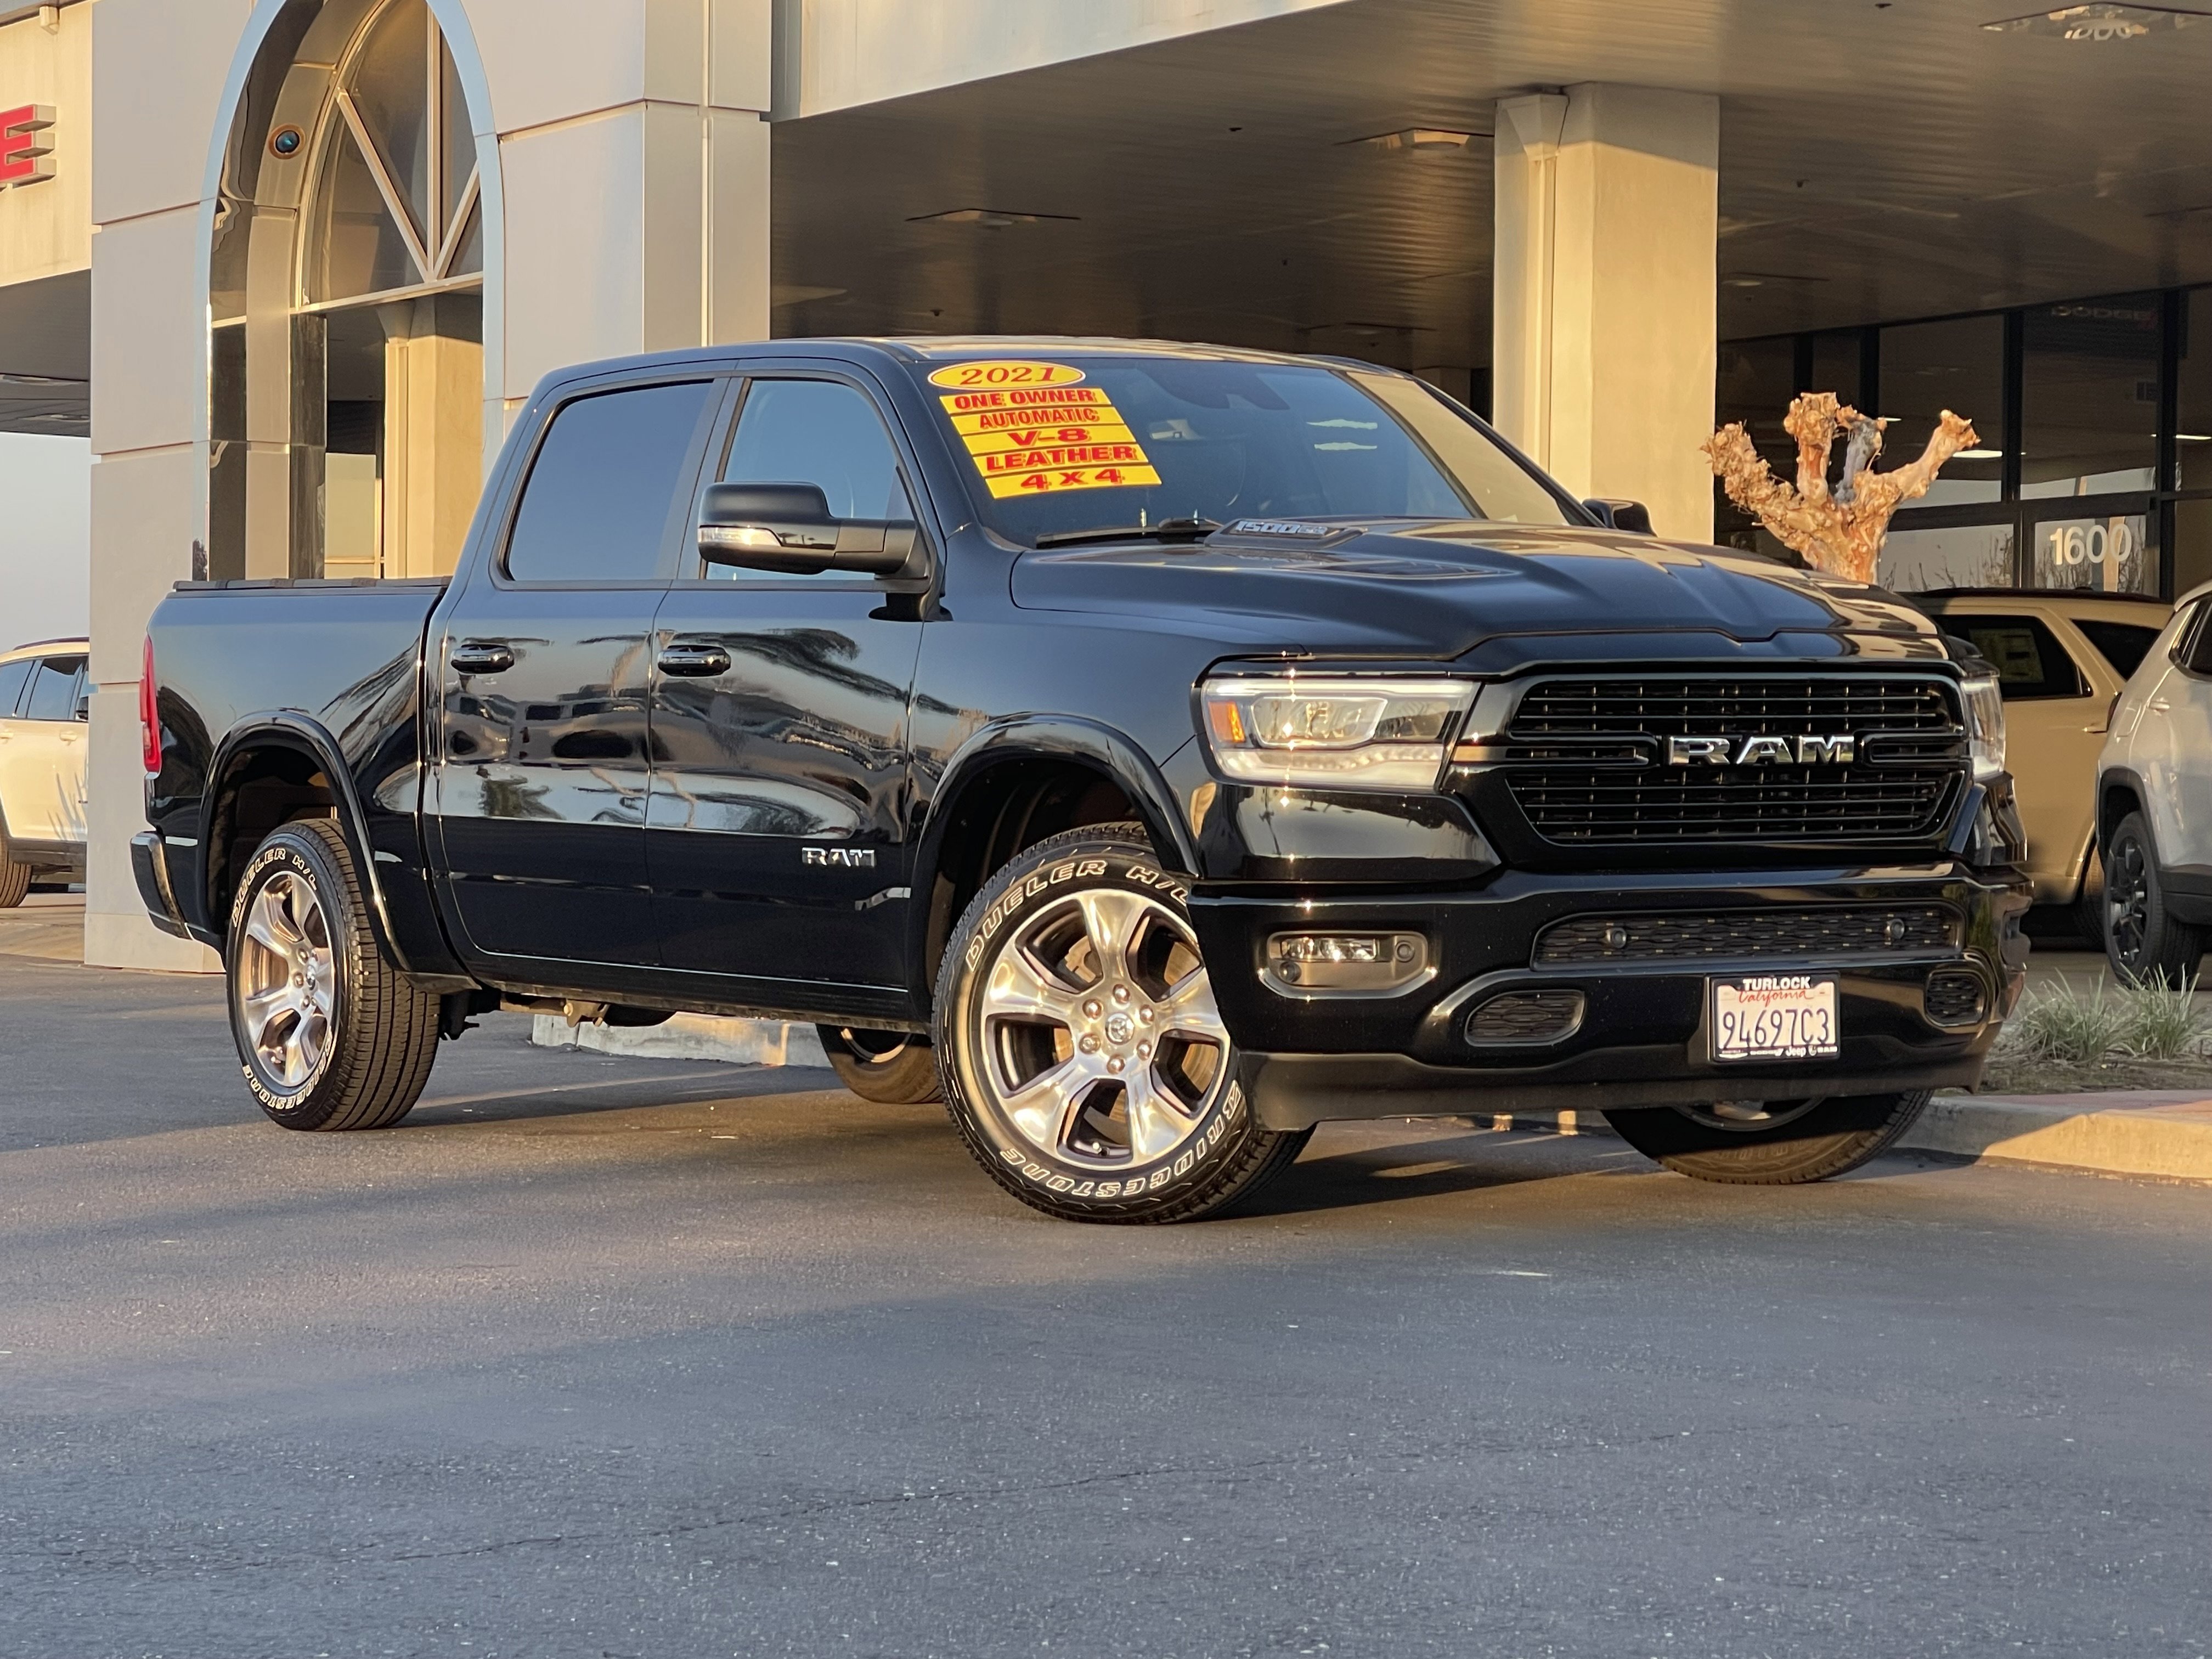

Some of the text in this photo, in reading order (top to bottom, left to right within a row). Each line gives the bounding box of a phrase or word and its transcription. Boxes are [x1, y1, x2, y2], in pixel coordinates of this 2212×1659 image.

[959, 366, 1056, 385] 2021
[955, 389, 1096, 410] ONE OWNER
[980, 408, 1099, 428] AUTOMATIC
[1007, 428, 1091, 446] V-8
[986, 445, 1137, 472] LEATHER
[1234, 521, 1300, 533] 1500
[2050, 523, 2131, 565] 1600
[1669, 735, 1854, 765] RAM
[802, 847, 877, 867] RAM
[232, 848, 286, 927] DUELER
[966, 860, 1107, 972] DUELER
[1742, 976, 1811, 991] TURLOCK
[1738, 989, 1814, 1007] California
[1723, 1008, 1829, 1048] 94697C3
[1785, 1046, 1807, 1057] Jeep
[1000, 1080, 1242, 1197] BRIDGESTONE
